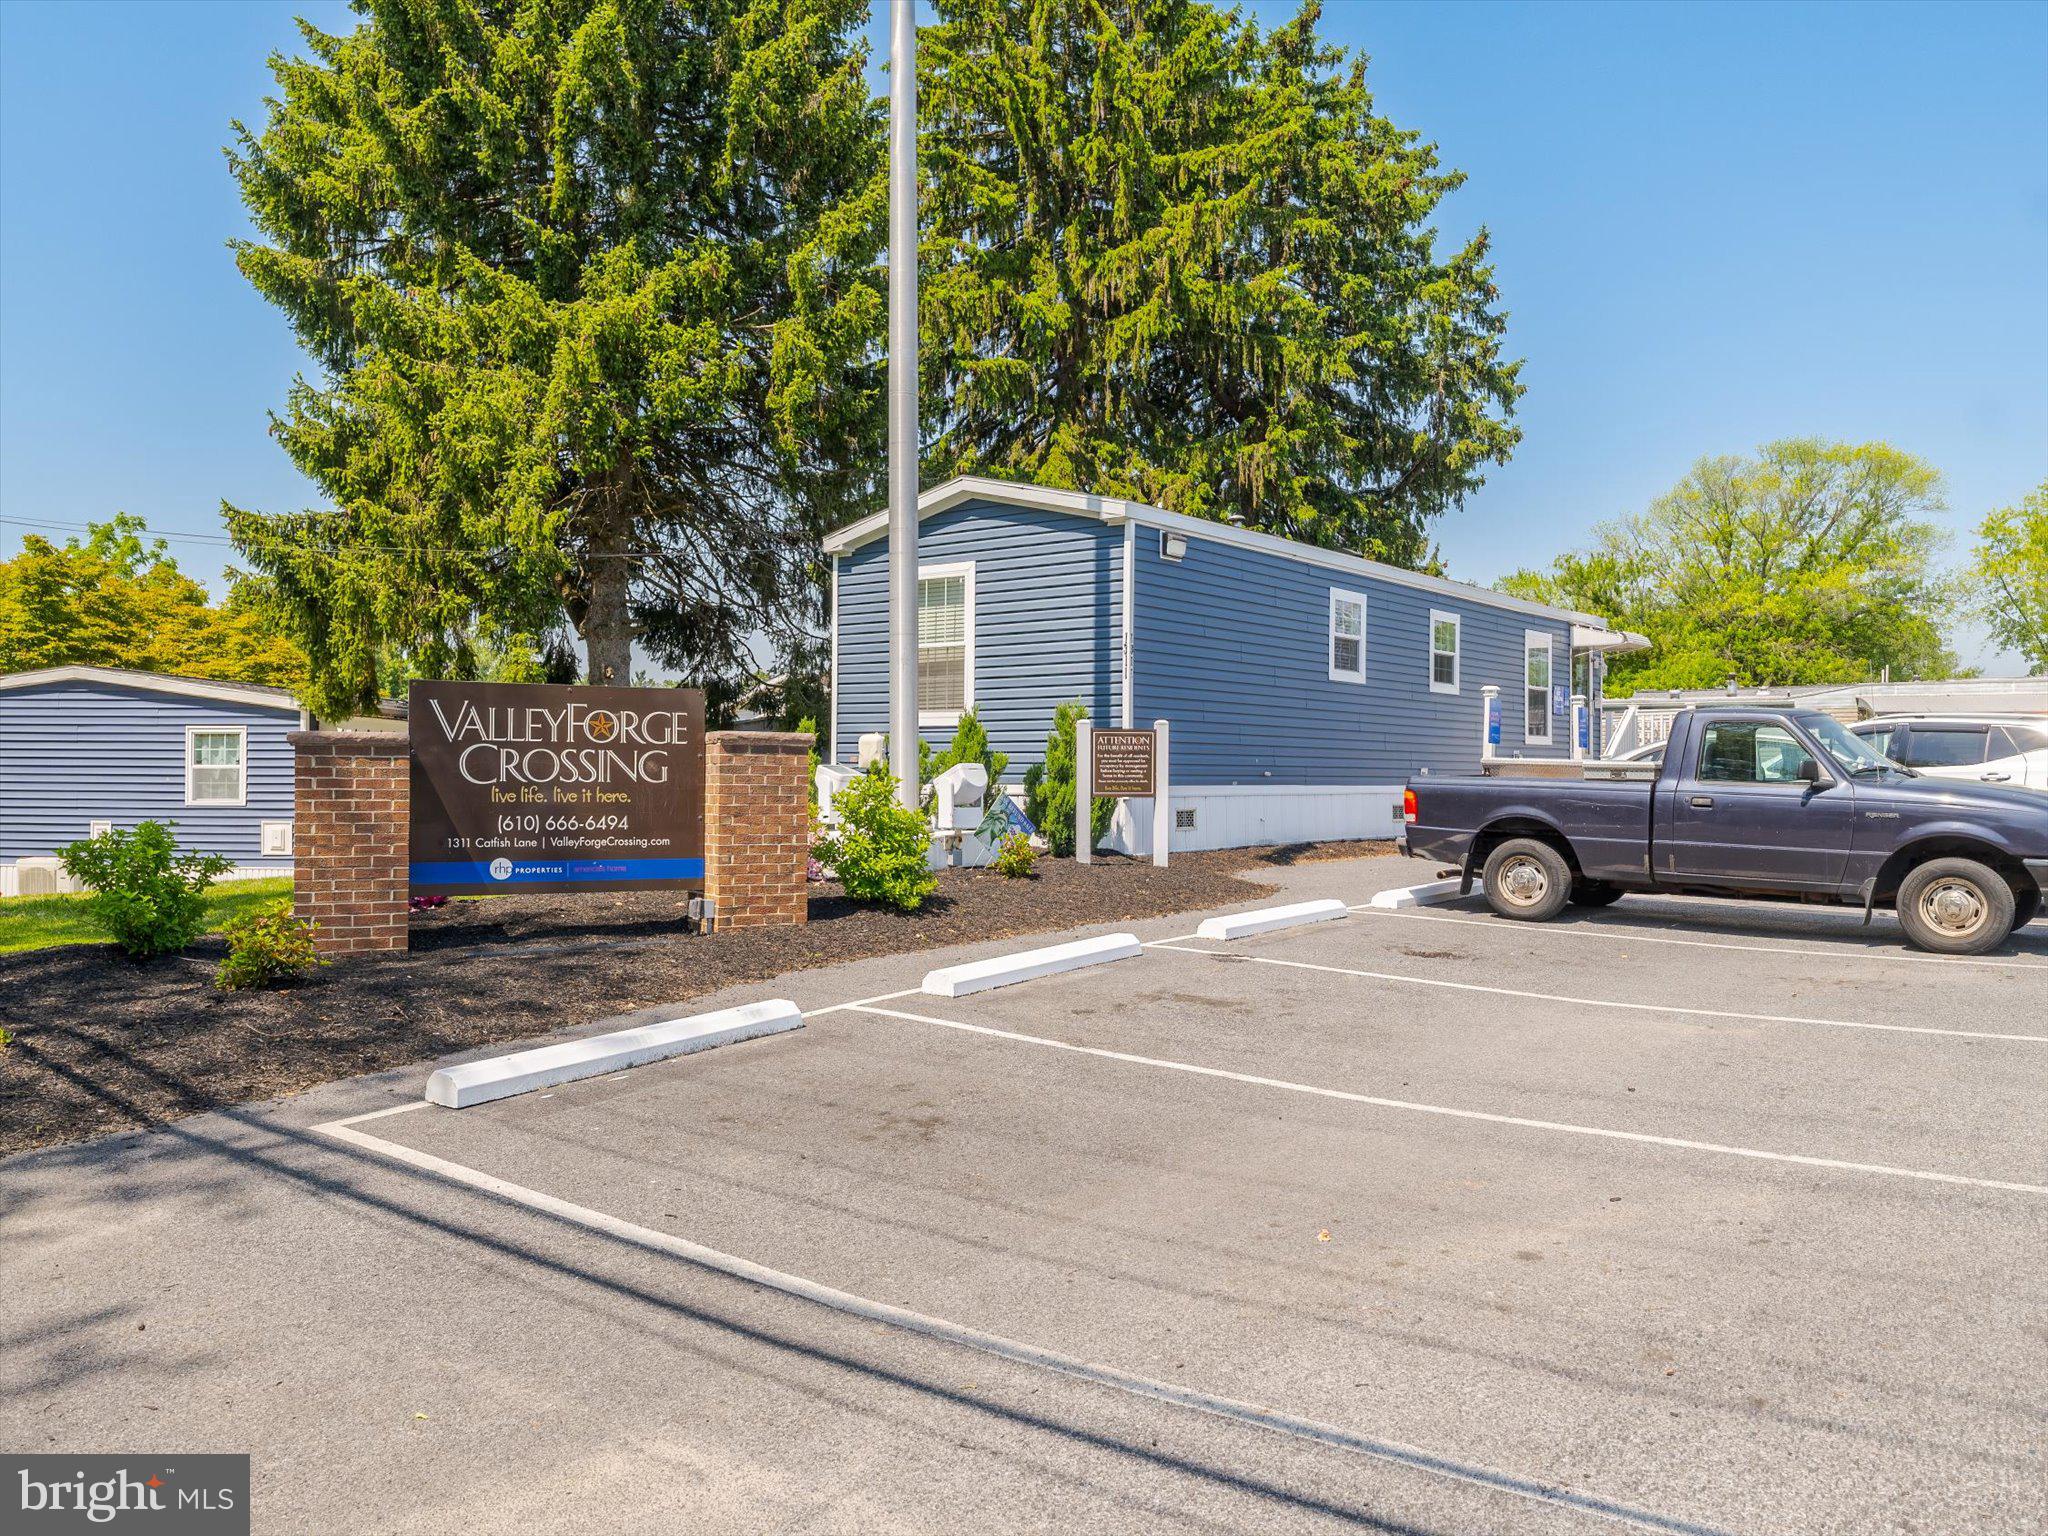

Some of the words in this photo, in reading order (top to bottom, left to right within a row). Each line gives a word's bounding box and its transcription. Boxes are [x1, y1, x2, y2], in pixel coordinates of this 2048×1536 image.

[1097, 736, 1150, 745] ATTENTION
[459, 743, 668, 784] CROSSING
[491, 785, 517, 803] live
[520, 785, 548, 803] life.
[553, 785, 578, 803] live
[582, 788, 592, 803] it
[596, 786, 631, 803] here.
[498, 814, 540, 834] (610)
[545, 815, 629, 831] 666-6494
[447, 837, 470, 848] 1311
[475, 836, 511, 848] Catfish
[514, 837, 538, 848] Lane
[550, 836, 671, 849] ValleyForgeCrossing.com
[515, 866, 564, 874] PROPERTIES
